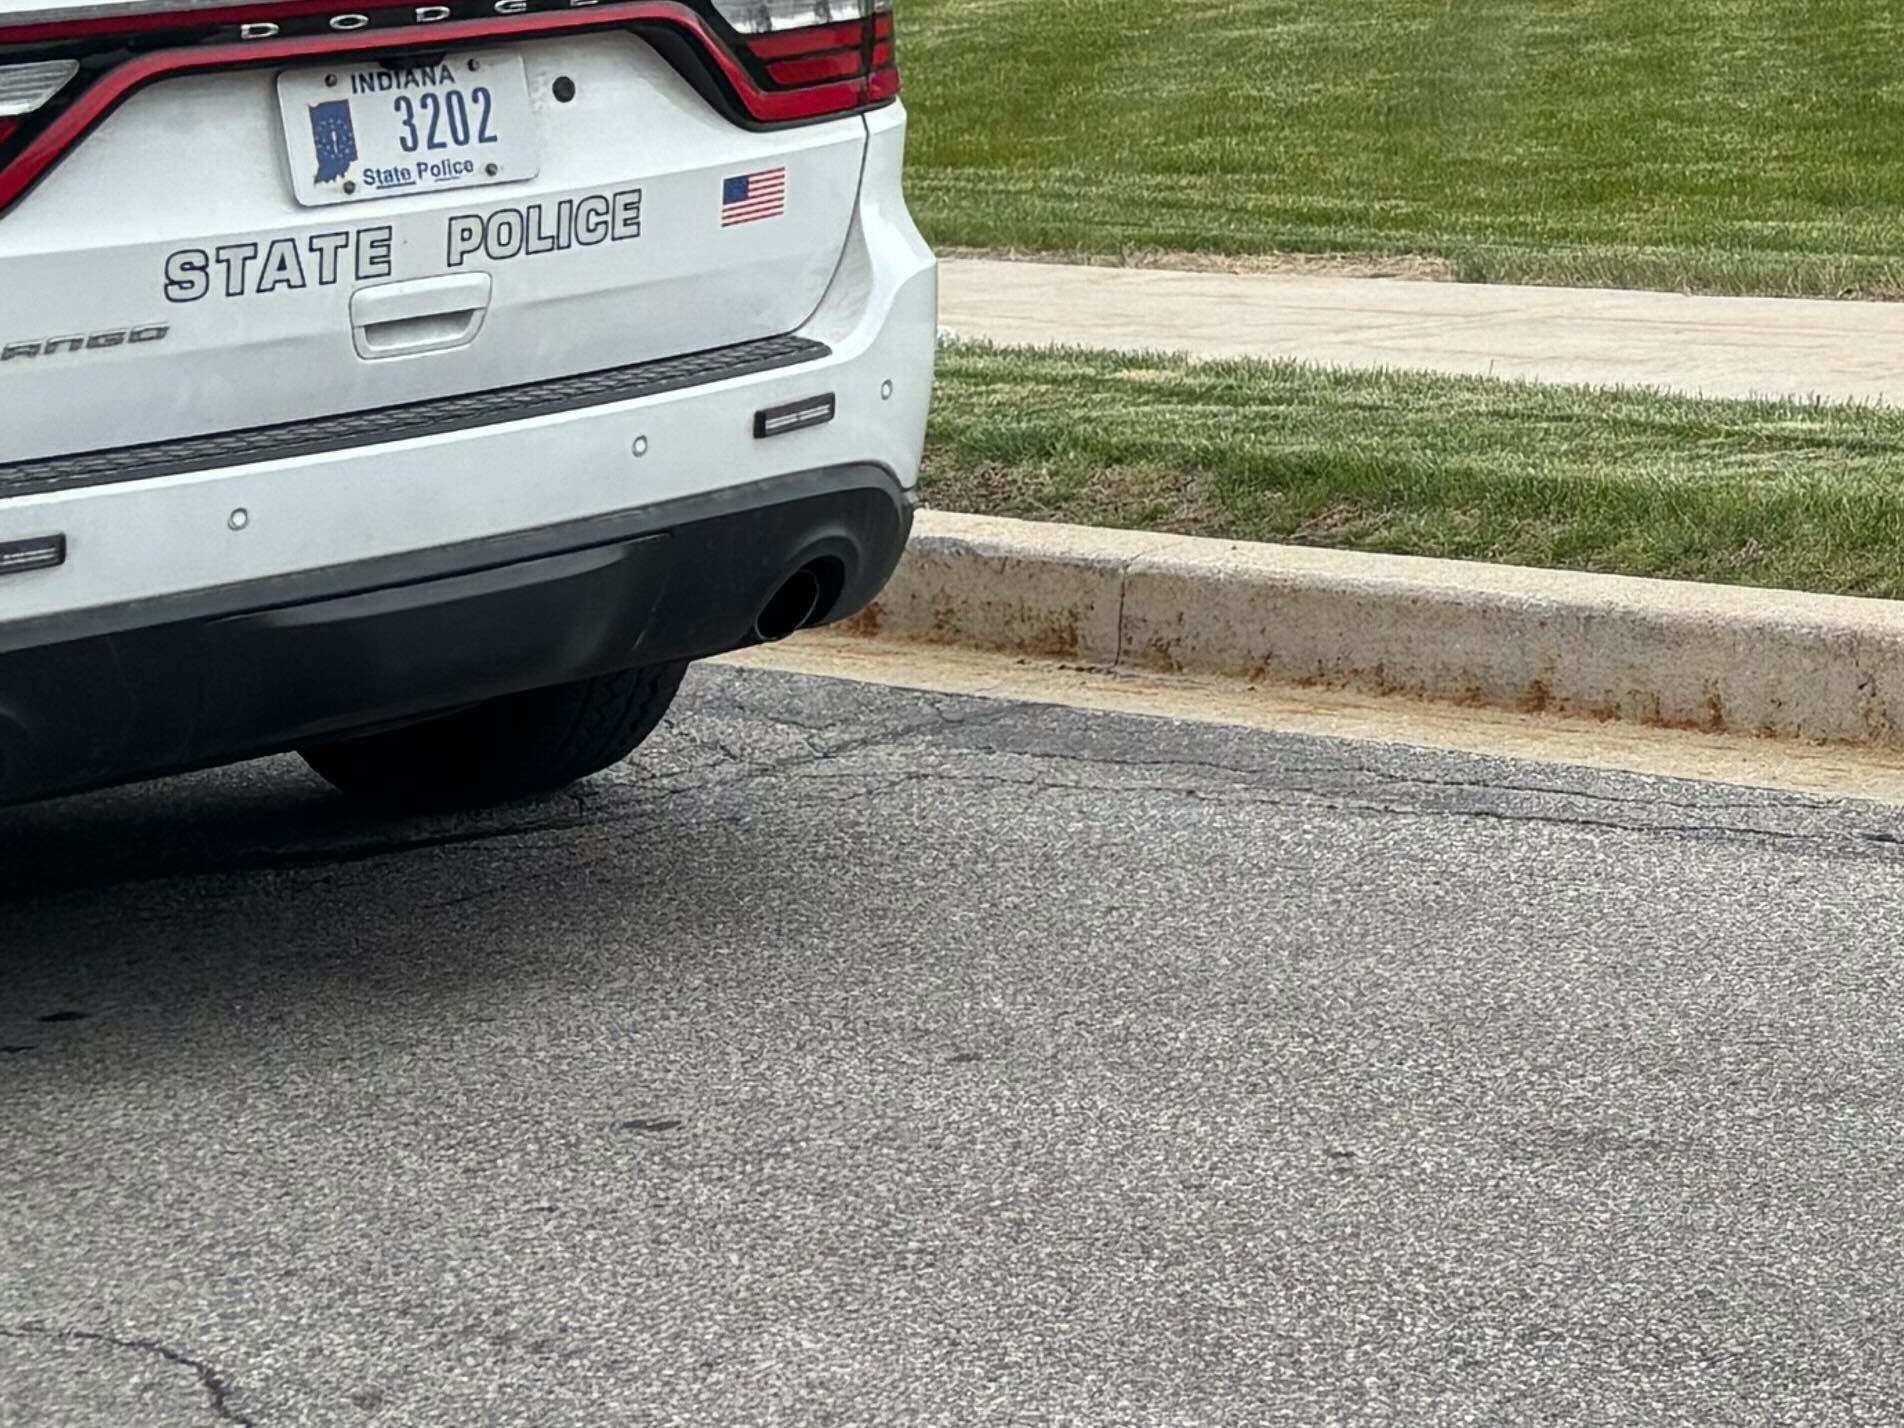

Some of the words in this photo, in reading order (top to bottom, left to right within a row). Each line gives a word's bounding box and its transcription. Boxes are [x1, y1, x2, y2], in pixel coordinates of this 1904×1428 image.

[351, 64, 456, 94] INDIANA
[394, 86, 498, 153] 3202
[362, 164, 413, 187] State
[417, 158, 474, 179] Police
[164, 224, 393, 303] STATE
[446, 188, 642, 267] POLICE
